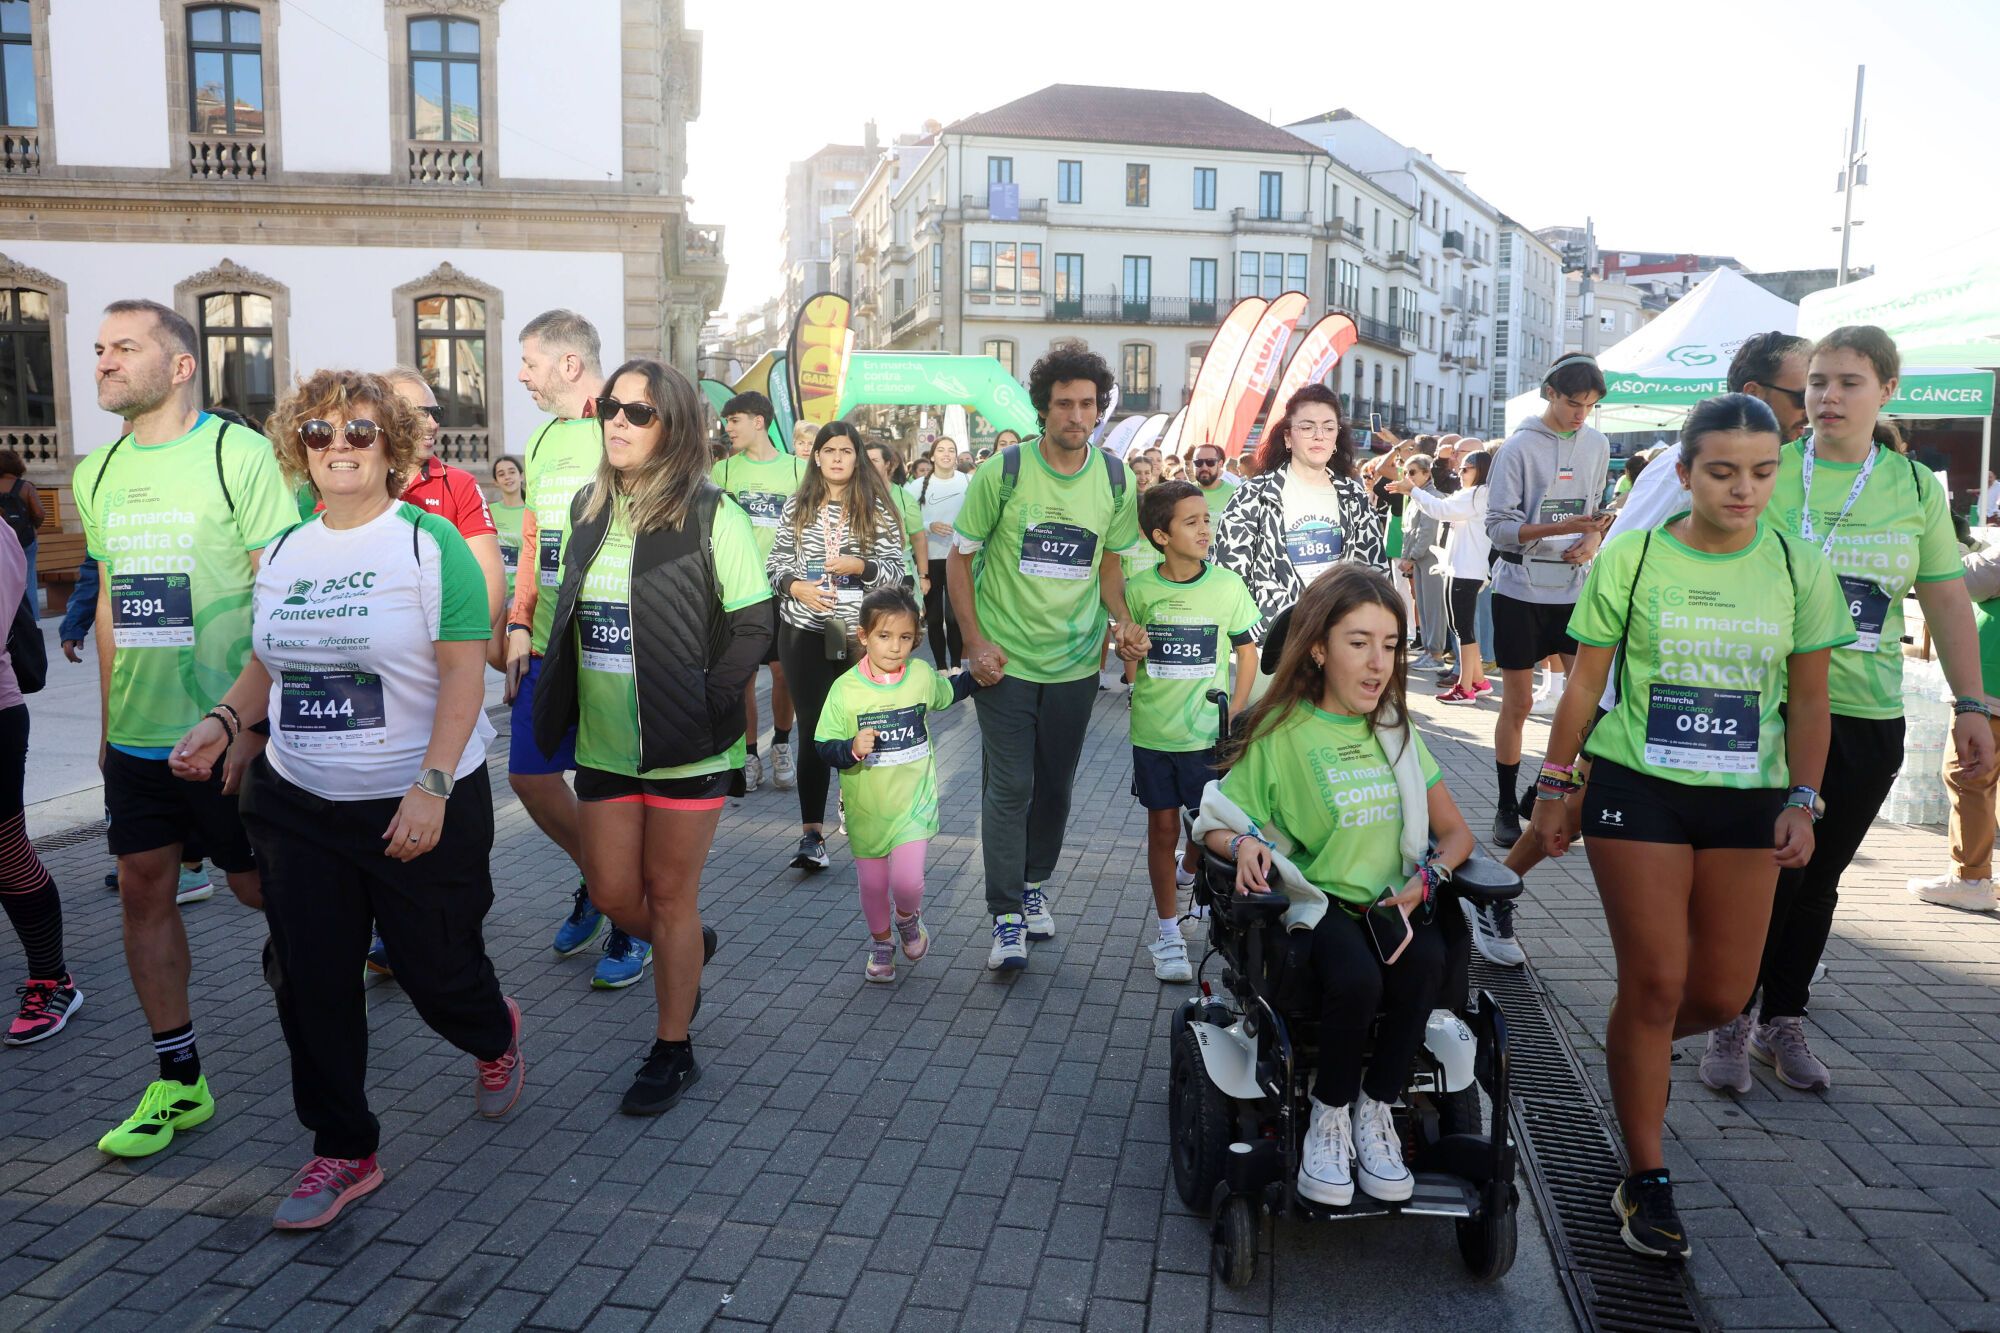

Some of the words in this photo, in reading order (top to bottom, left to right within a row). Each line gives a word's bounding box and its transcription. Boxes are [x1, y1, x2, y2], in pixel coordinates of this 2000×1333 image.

[1910, 386, 1983, 402] CÁNCER
[425, 498, 440, 506] HH
[108, 512, 126, 528] En
[130, 507, 195, 526] marcha
[107, 530, 171, 552] contra
[177, 533, 193, 549] o
[1041, 540, 1079, 557] 0177
[1298, 542, 1332, 557] 1881
[1829, 547, 1889, 568] ntra
[1896, 554, 1910, 569] o
[122, 598, 165, 616] 2391
[270, 604, 369, 620] Pontevedra
[1155, 611, 1168, 622] En
[1171, 613, 1214, 624] marcha
[1661, 611, 1688, 629] En
[1695, 616, 1779, 636] marcha
[592, 625, 631, 644] 2390
[1648, 585, 1659, 679] PONTEVEDRA
[276, 639, 309, 648] aecc
[318, 636, 370, 648] infocáncer
[1162, 643, 1202, 657] 0235
[1659, 636, 1752, 661] contra
[1761, 646, 1775, 662] o
[1660, 661, 1767, 685] cancro
[1653, 687, 1699, 698] Pontevedra
[1663, 696, 1694, 705] marcha
[299, 698, 355, 719] 2444
[1652, 702, 1677, 710] contra
[1685, 706, 1714, 714] cancro
[1676, 713, 1738, 735] 0812
[880, 725, 915, 742] 0174
[1328, 768, 1351, 783] En
[1334, 782, 1399, 807] contra
[1198, 1031, 1211, 1046] Mini
